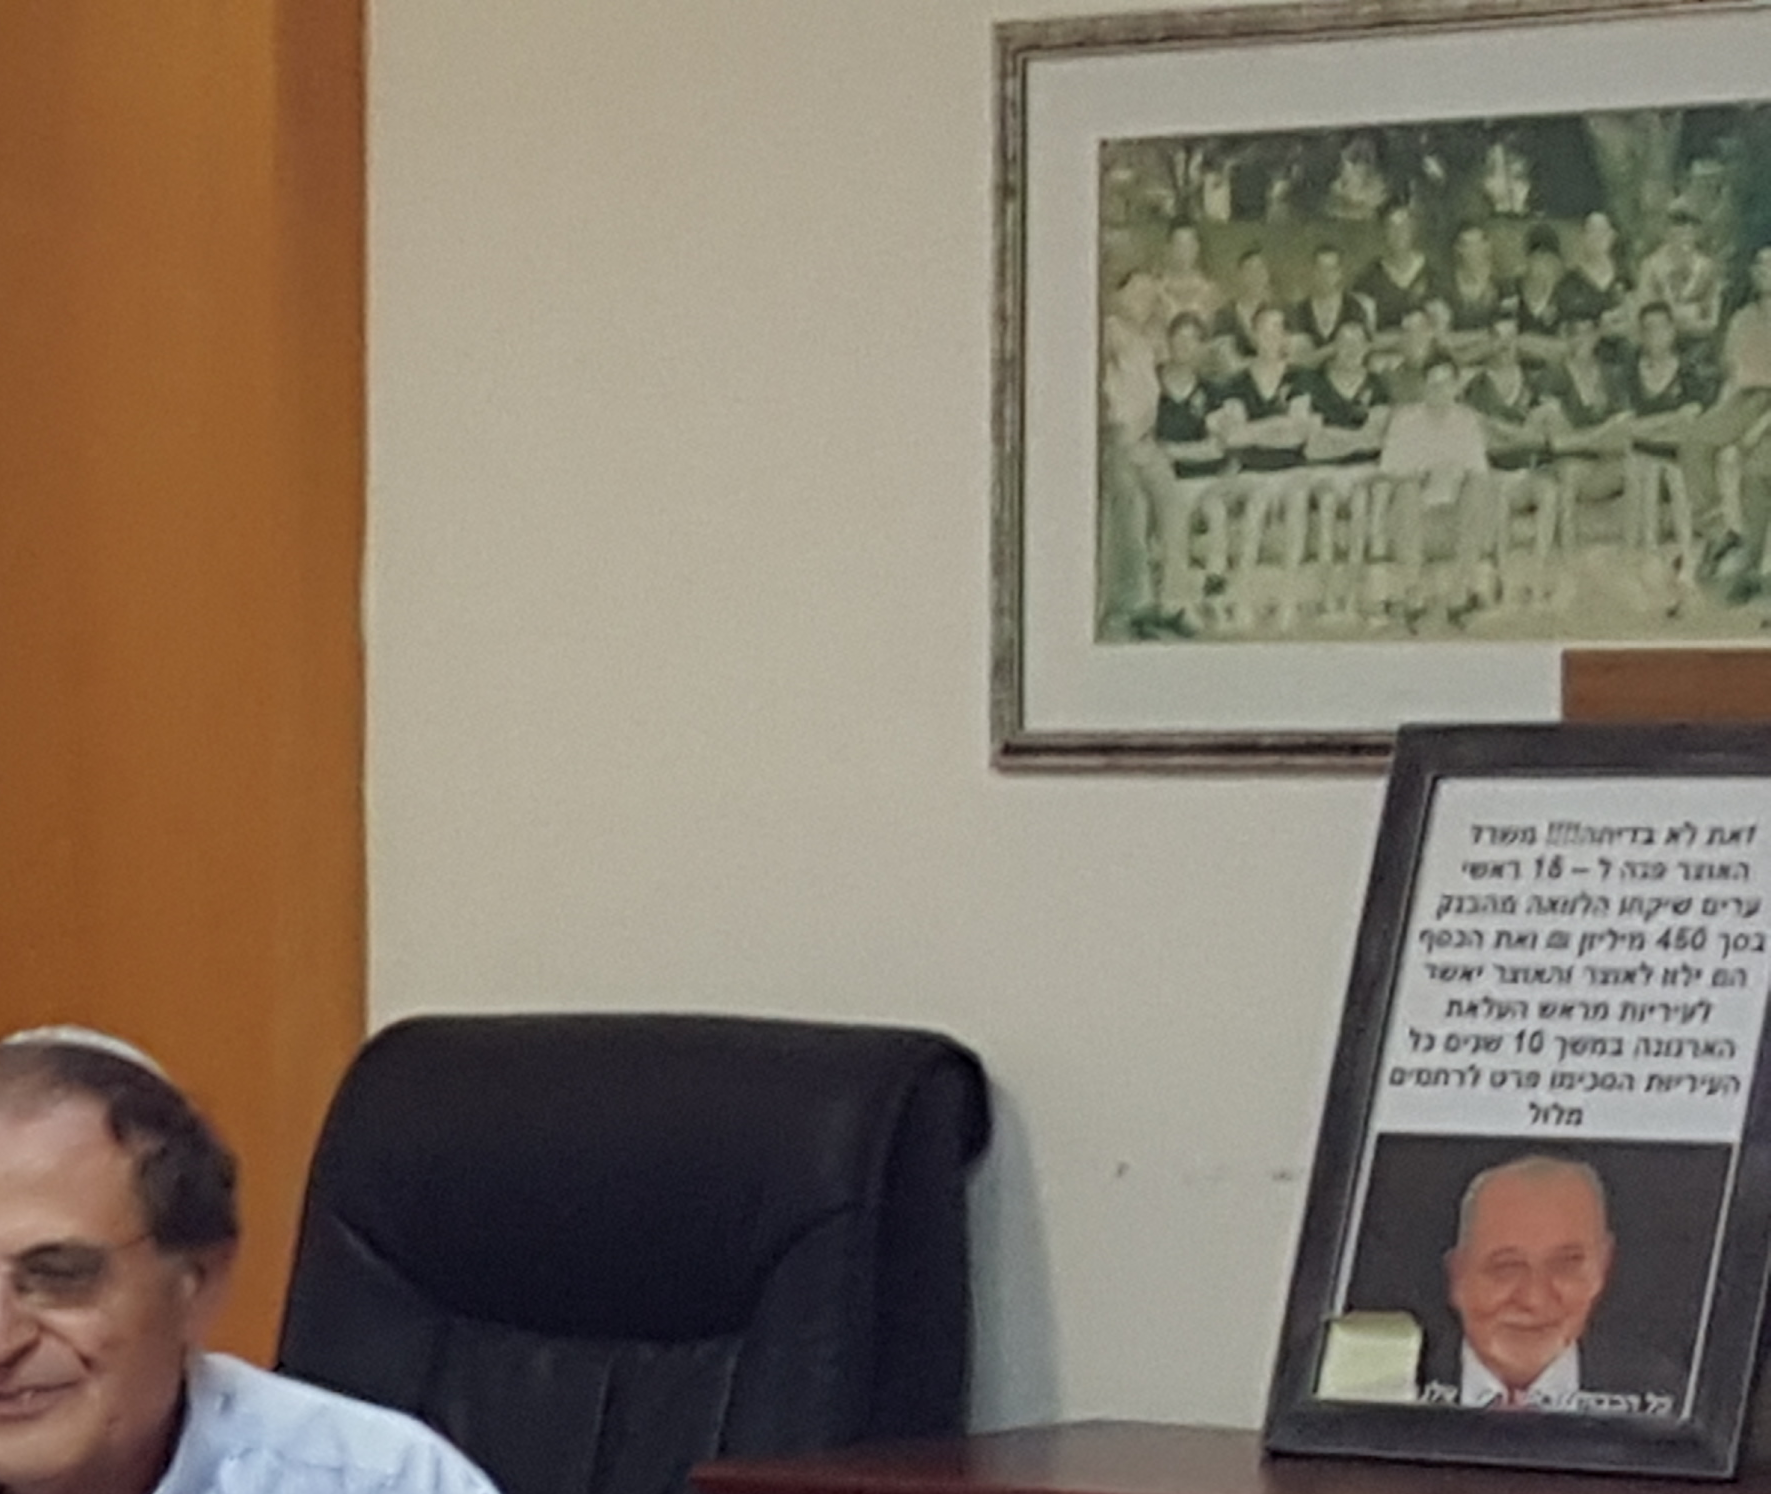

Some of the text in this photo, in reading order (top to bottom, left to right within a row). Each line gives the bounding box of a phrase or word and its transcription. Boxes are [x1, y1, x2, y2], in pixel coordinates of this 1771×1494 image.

[1469, 823, 1538, 847] משרד
[1664, 821, 1699, 848] לא
[1706, 823, 1757, 847] זאת
[1461, 860, 1522, 881] ראשי
[1619, 860, 1669, 881] פנה
[1676, 860, 1751, 882] האוצר
[1434, 894, 1518, 921] מהבנק
[1700, 896, 1762, 920] ערים
[1418, 929, 1485, 954] הכסף
[1493, 930, 1539, 951] ואת
[1576, 928, 1647, 958] מיליון
[1716, 930, 1767, 960] בסך
[1422, 963, 1485, 984] יאשר
[1583, 961, 1655, 987] לאוצר
[1710, 966, 1748, 988] הם
[1444, 995, 1716, 1025] לעיריות מראש העלאת
[1407, 1027, 1437, 1053] כל
[1442, 1031, 1504, 1053] שנים
[1553, 1033, 1625, 1063] במשך
[1632, 1034, 1737, 1060] הארנונה
[1387, 1063, 1743, 1097] העיריות הסכימו פרט לרחמים
[1527, 1100, 1585, 1127] מלול
